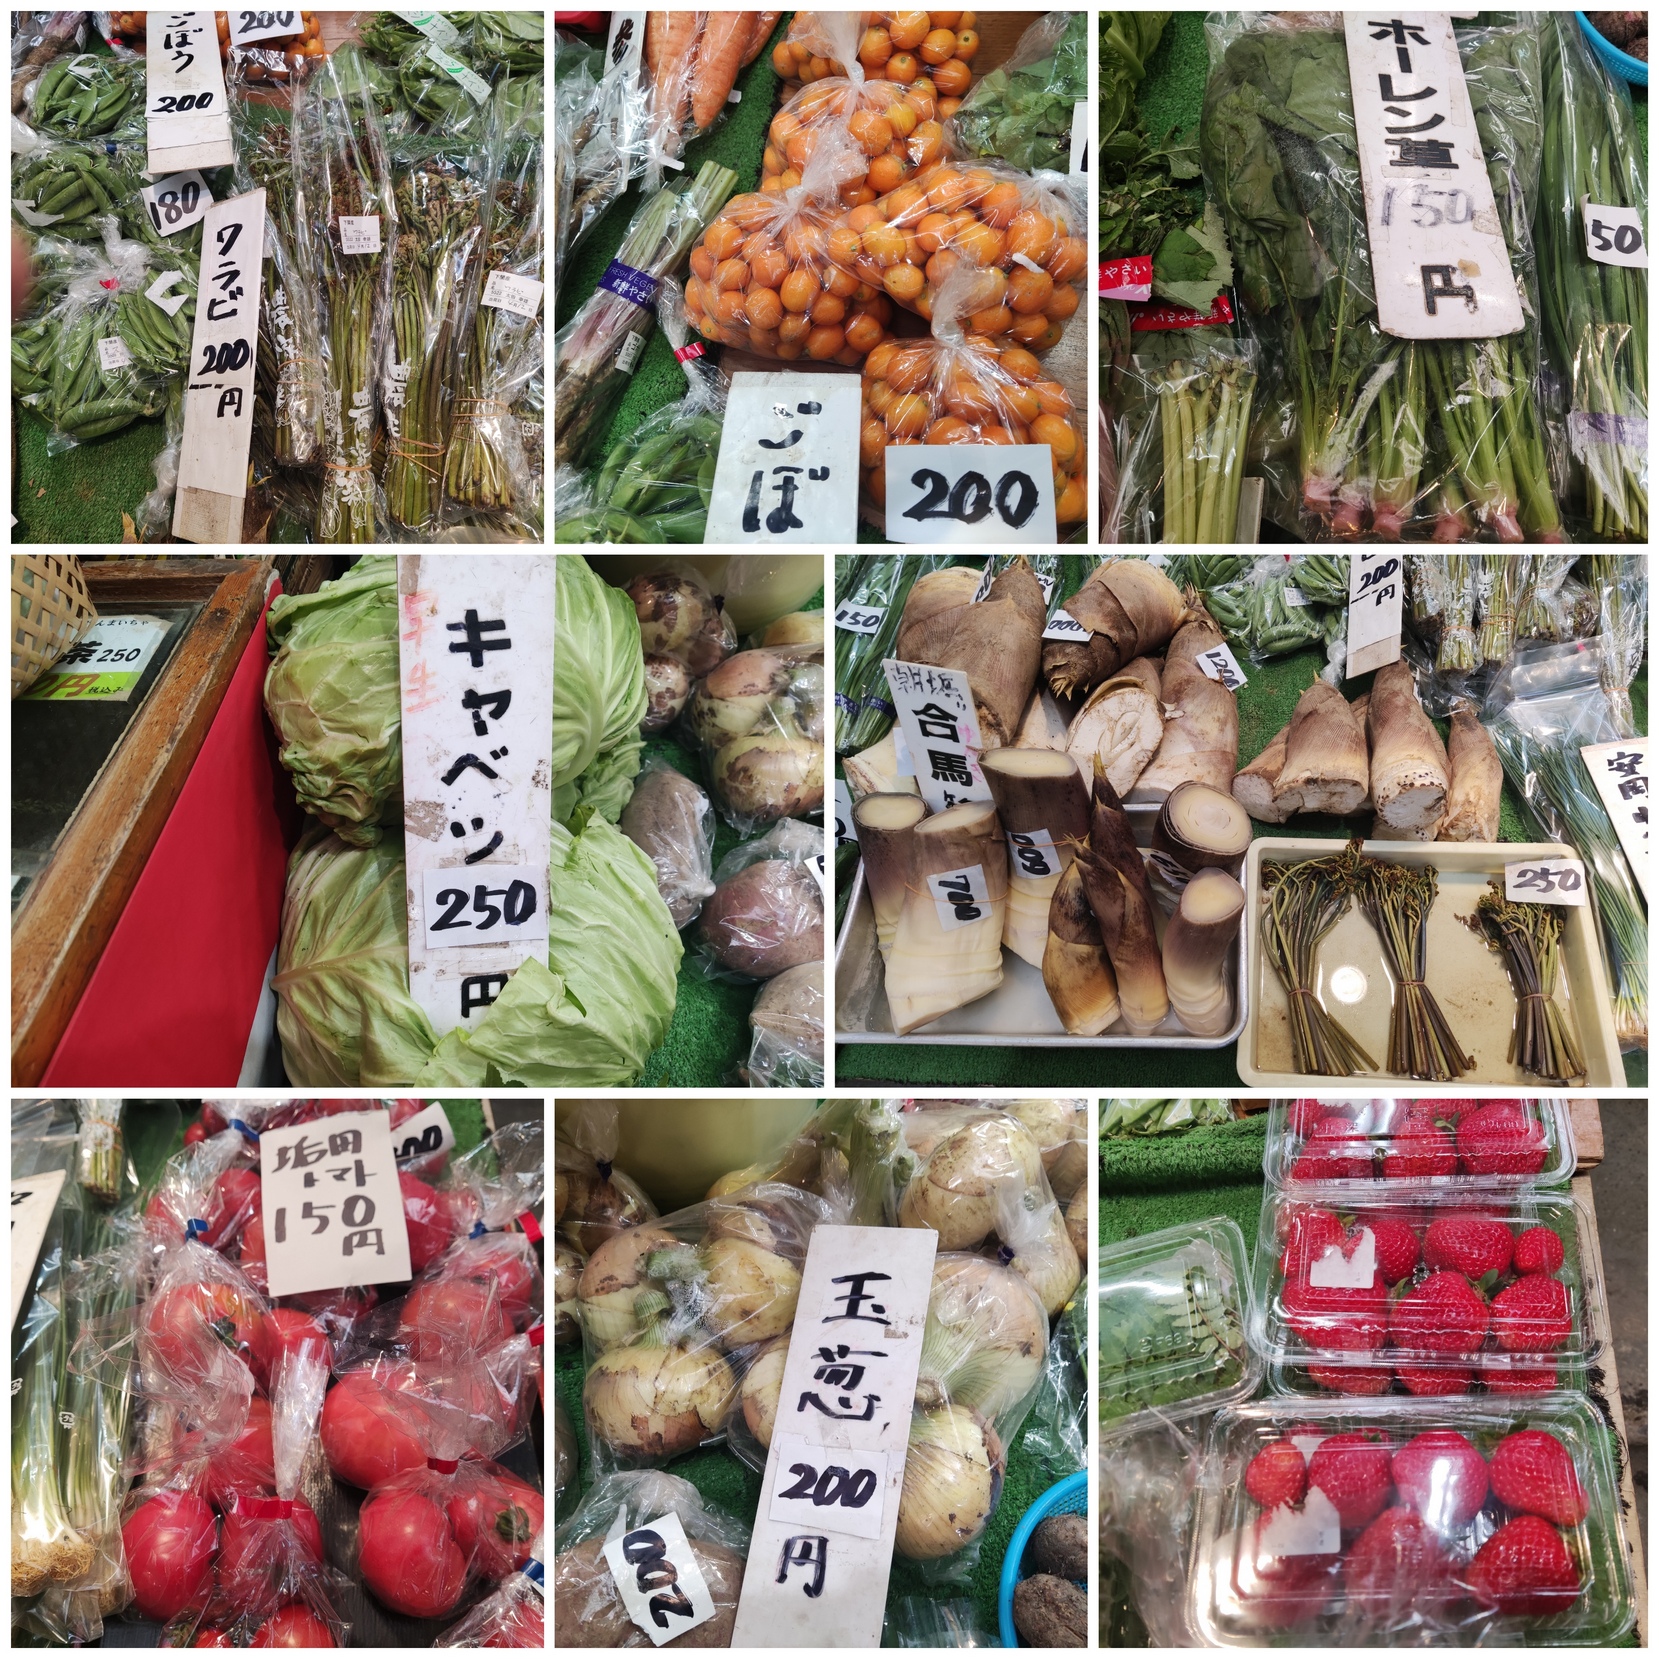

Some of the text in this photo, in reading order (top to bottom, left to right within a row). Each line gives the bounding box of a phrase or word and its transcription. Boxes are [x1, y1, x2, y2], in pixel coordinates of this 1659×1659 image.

[163, 11, 204, 74] ごぼう
[238, 11, 295, 34] 200
[151, 92, 214, 113] 200
[150, 181, 200, 230] 180
[1380, 183, 1476, 228] 150
[207, 223, 243, 321] ワラビ
[608, 265, 628, 279] FRESH
[1420, 263, 1479, 317] 円
[197, 338, 251, 376] 200
[216, 387, 243, 418] 円
[742, 401, 830, 533] ごぼ
[901, 467, 1041, 529] 200
[1357, 558, 1399, 594] 200
[1376, 584, 1395, 607] 円
[835, 609, 880, 628] 150
[96, 648, 141, 663] 250
[440, 609, 512, 865] キャベツ
[938, 874, 982, 921] 700
[1504, 866, 1582, 894] 250
[430, 879, 538, 931] 250
[303, 1159, 378, 1188] トマト
[274, 1194, 376, 1244] 150
[342, 1228, 386, 1257] 円
[777, 1462, 877, 1508] 200
[622, 1528, 695, 1629] 200
[774, 1535, 829, 1598] 円
